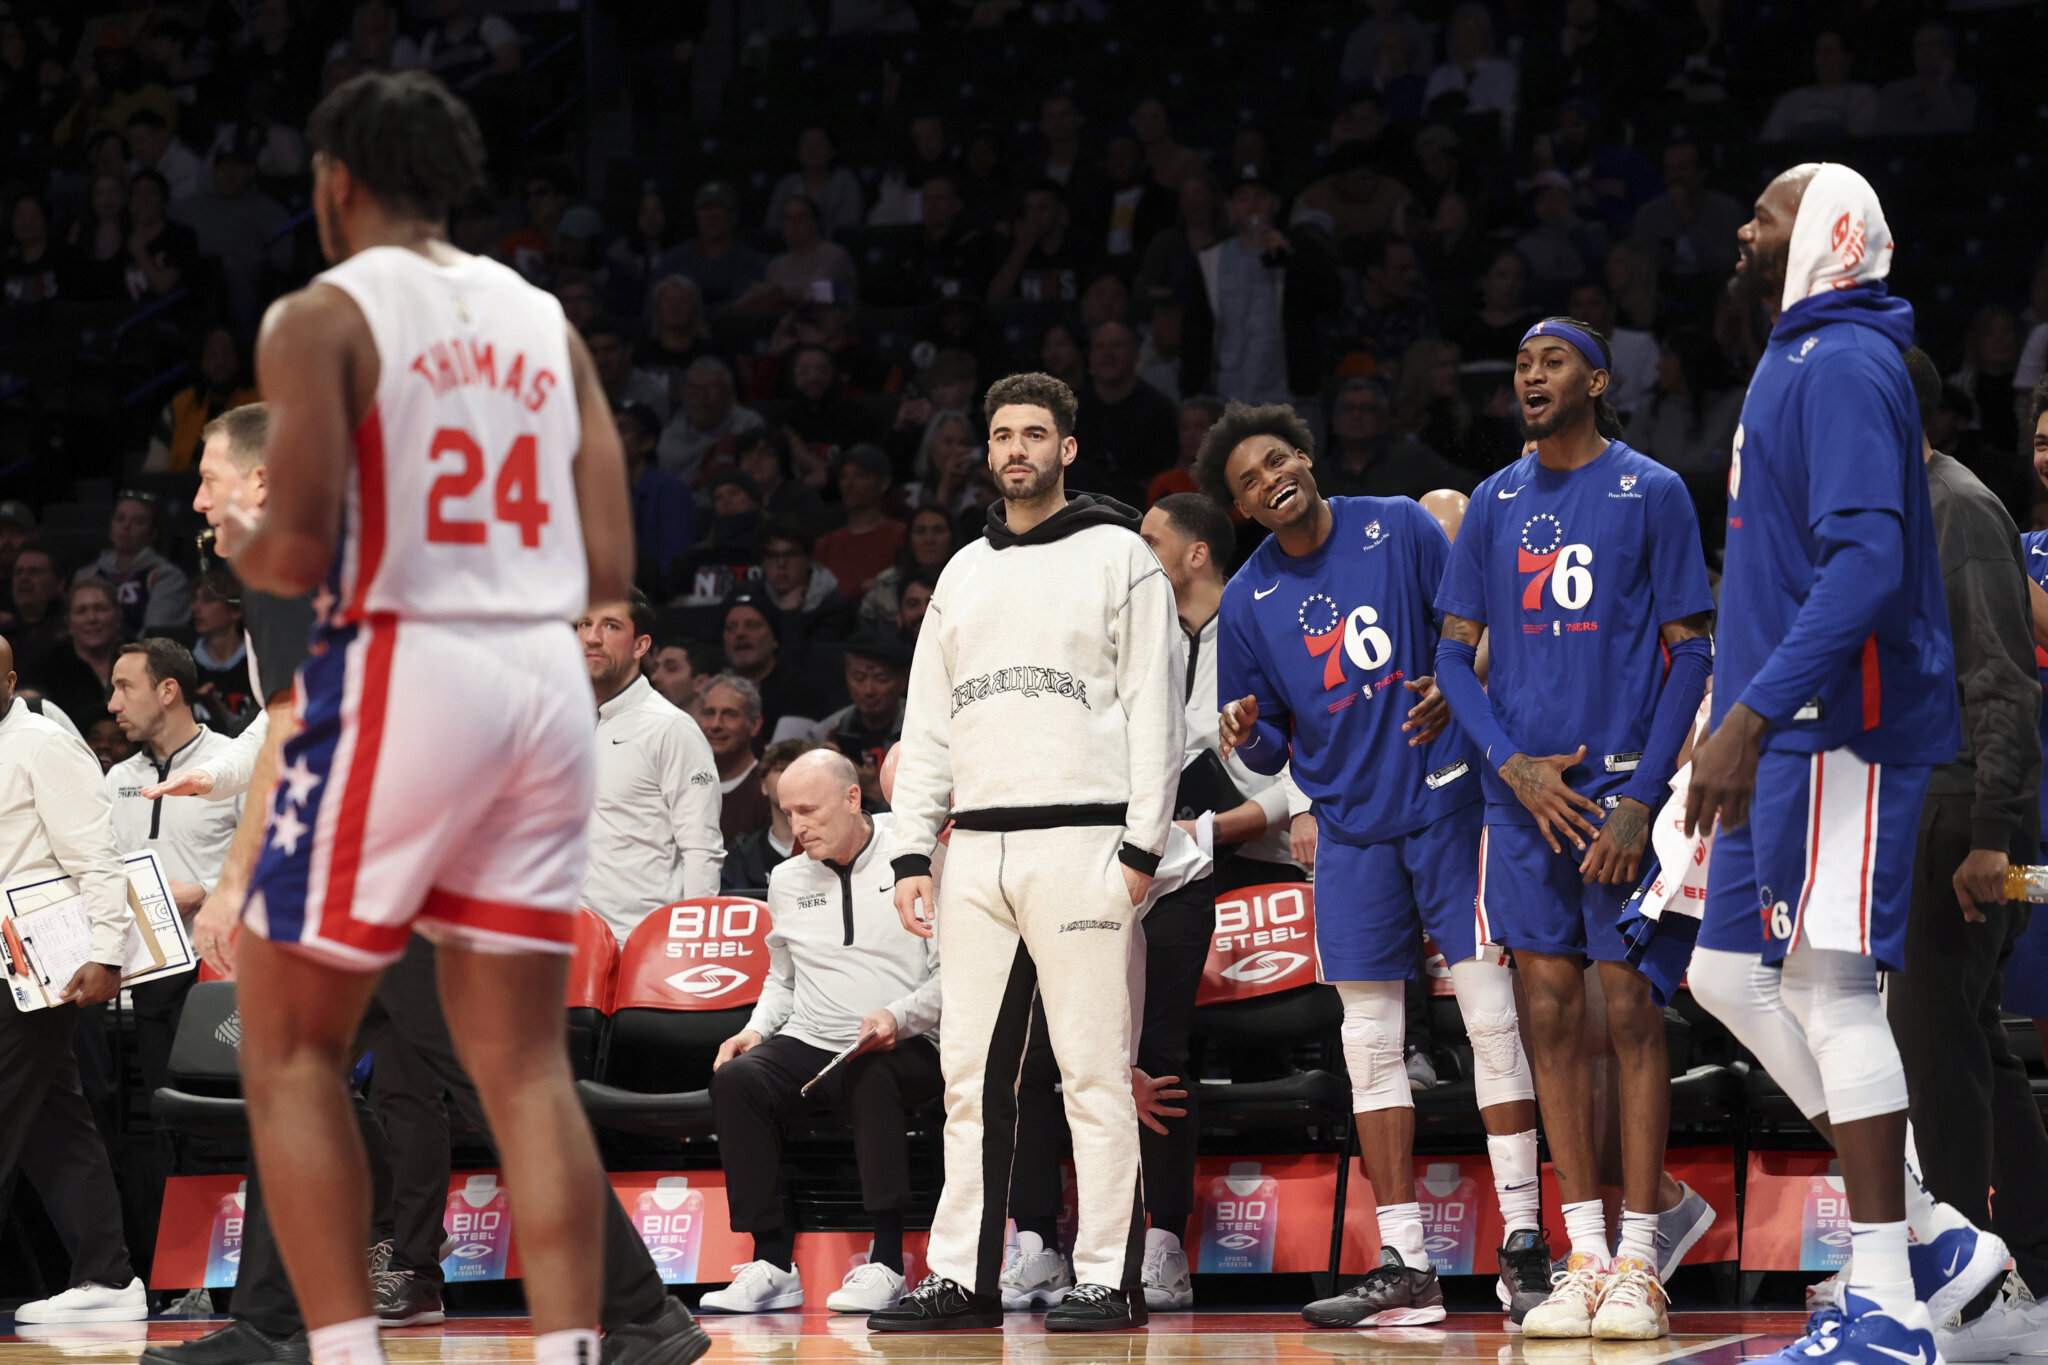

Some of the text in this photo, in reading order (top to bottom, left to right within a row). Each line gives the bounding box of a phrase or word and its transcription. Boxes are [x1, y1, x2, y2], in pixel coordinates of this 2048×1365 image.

[409, 337, 556, 412] THOMAS
[425, 427, 550, 548] 24
[1518, 543, 1594, 611] 76
[1303, 605, 1393, 691] 76
[798, 898, 827, 910] 76ERS
[1215, 889, 1305, 934] BIO
[668, 904, 759, 938] BIO
[1761, 900, 1792, 941] 76
[1215, 926, 1308, 952] STEEL
[666, 941, 754, 958] STEEL
[1217, 1201, 1266, 1220] BIO
[1817, 1198, 1850, 1217] BI
[452, 1211, 500, 1232] BIO
[643, 1214, 692, 1234] BIO
[1216, 1222, 1261, 1231] STEEL
[1424, 1224, 1461, 1233] TEEL
[453, 1232, 496, 1241] STEEL
[643, 1235, 687, 1244] STEEL
[453, 1269, 487, 1277] HYDRATION
